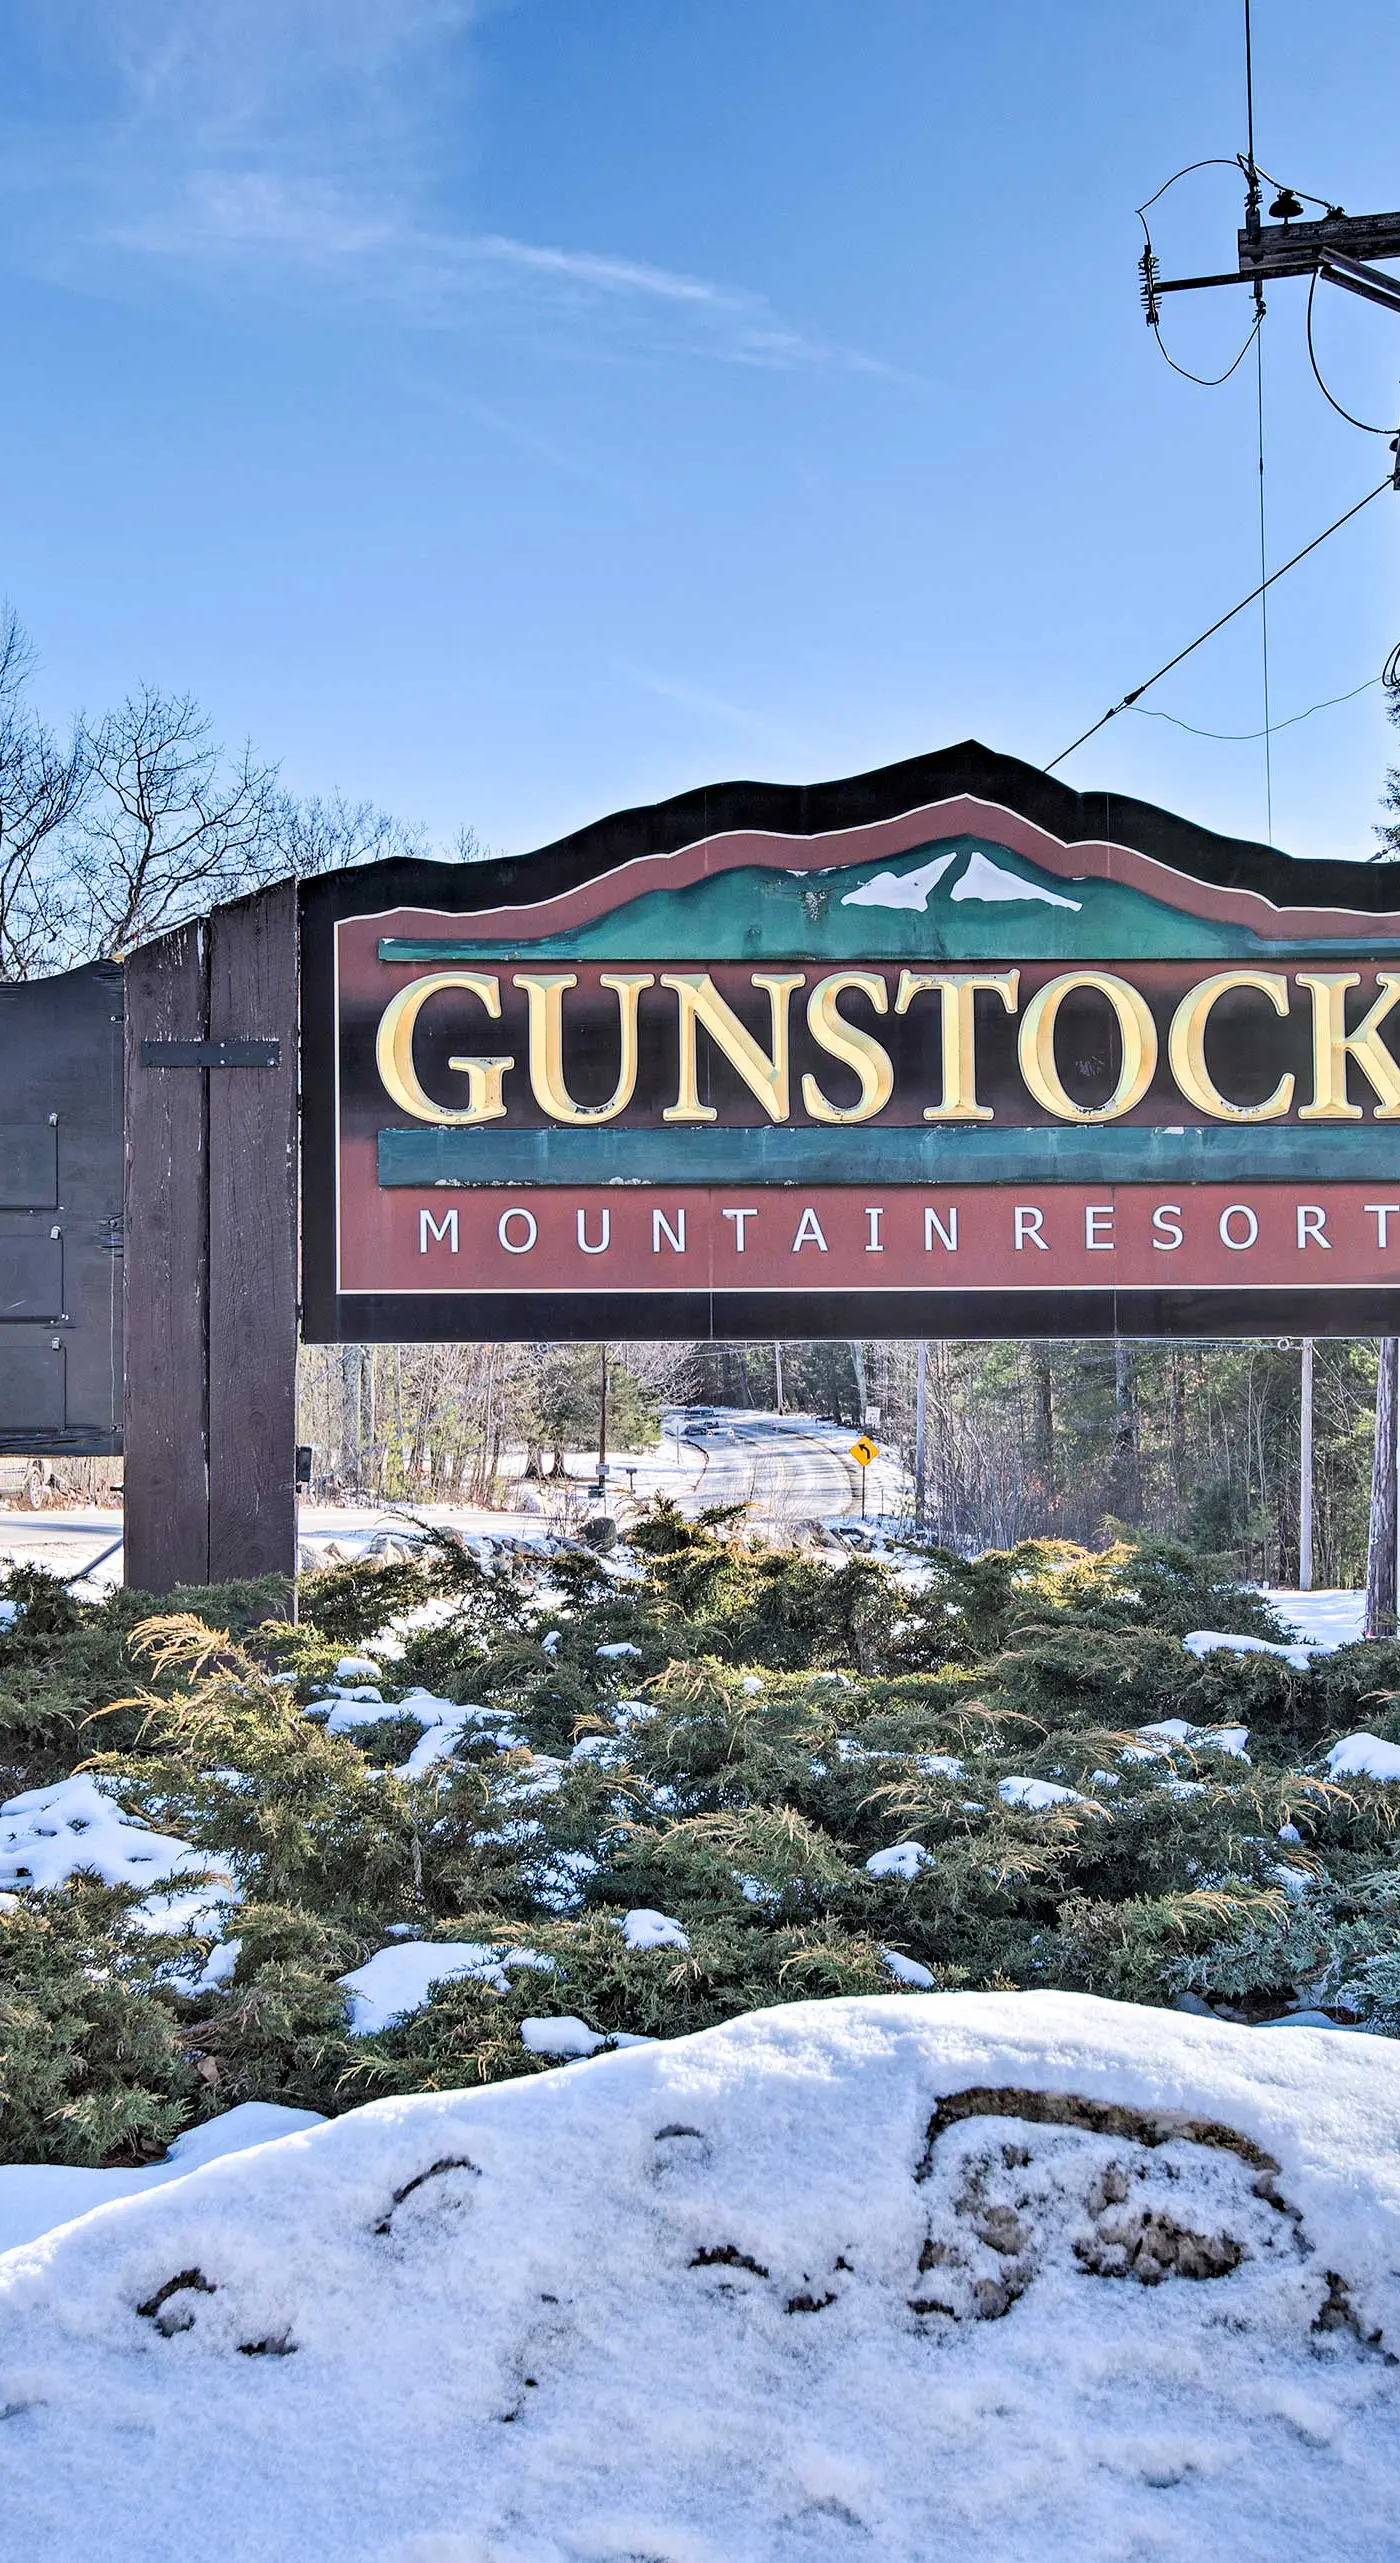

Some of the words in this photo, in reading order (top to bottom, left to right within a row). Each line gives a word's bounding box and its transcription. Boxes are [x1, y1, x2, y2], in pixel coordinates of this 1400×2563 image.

[376, 969, 1400, 1124] GUNSTOCK
[419, 1206, 958, 1254] MOUNTAIN
[1013, 1204, 1400, 1251] RESORT
